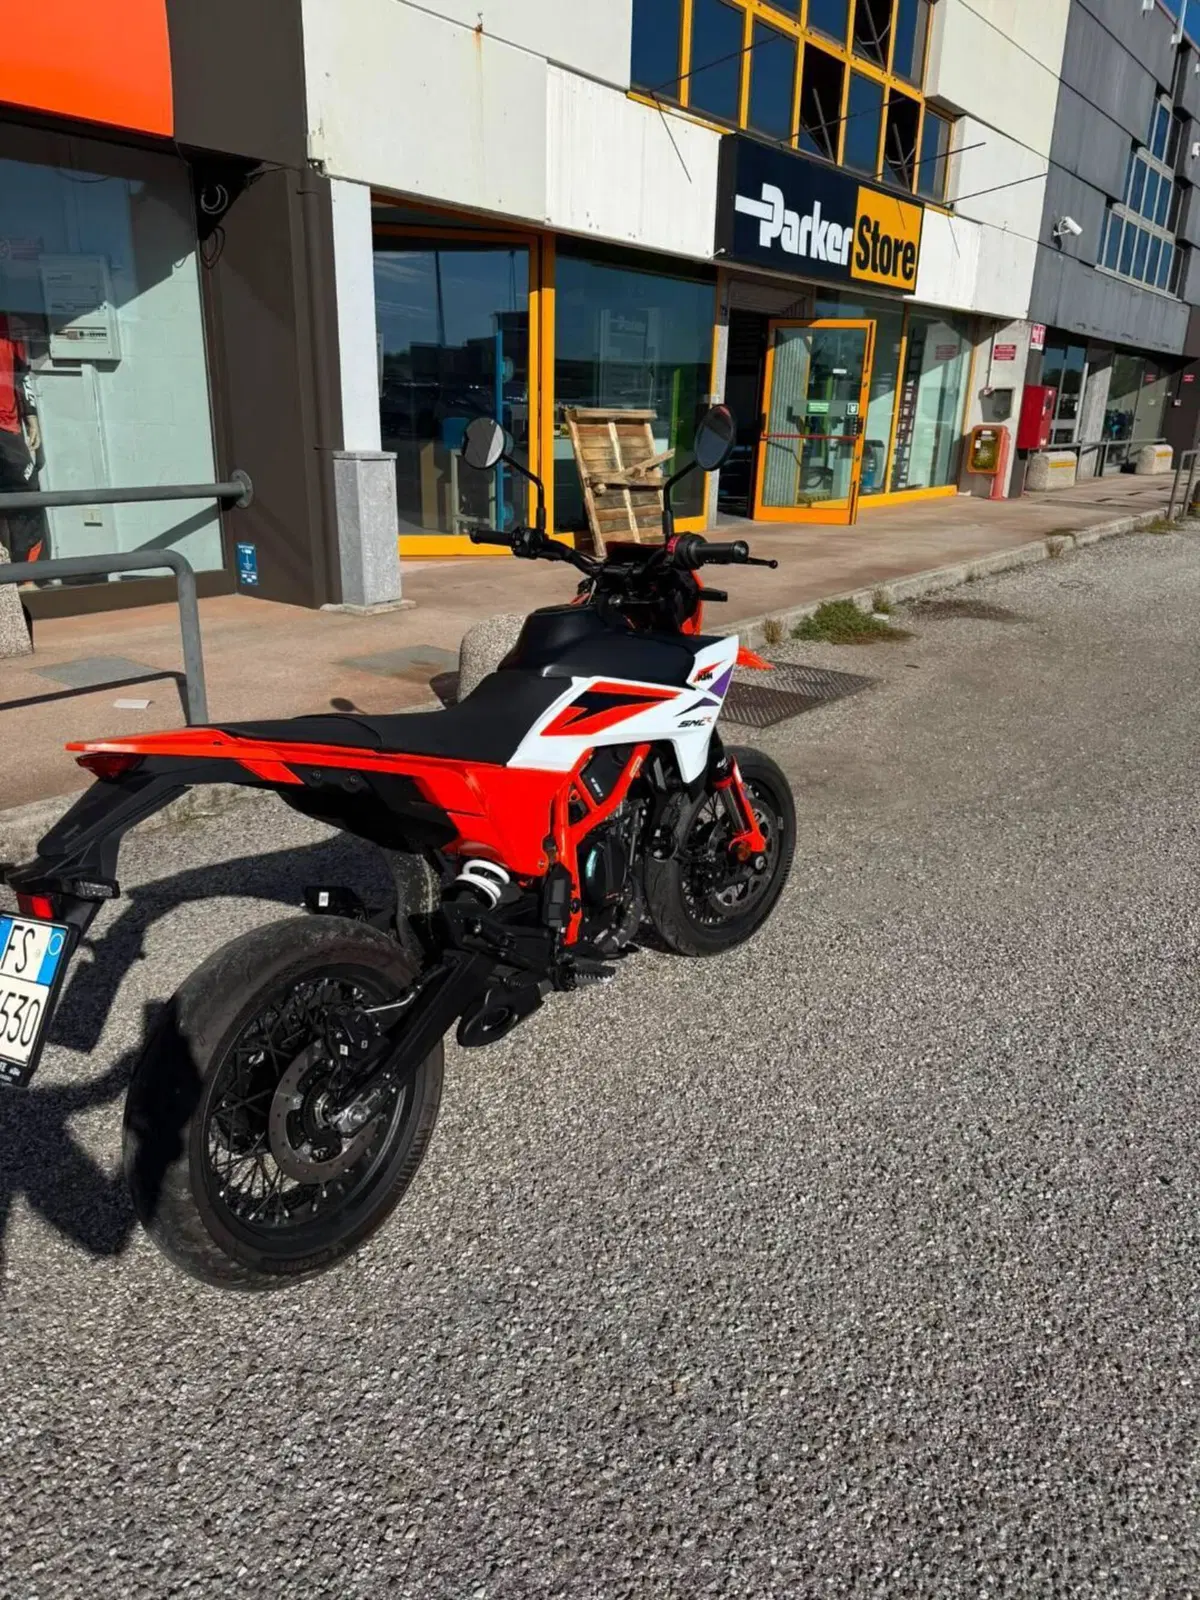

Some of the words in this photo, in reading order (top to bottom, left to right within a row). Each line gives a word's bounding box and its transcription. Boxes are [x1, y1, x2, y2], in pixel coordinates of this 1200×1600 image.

[735, 182, 853, 266] Parker
[855, 214, 916, 281] Store
[1, 925, 36, 973] FS
[0, 989, 41, 1047] 530
